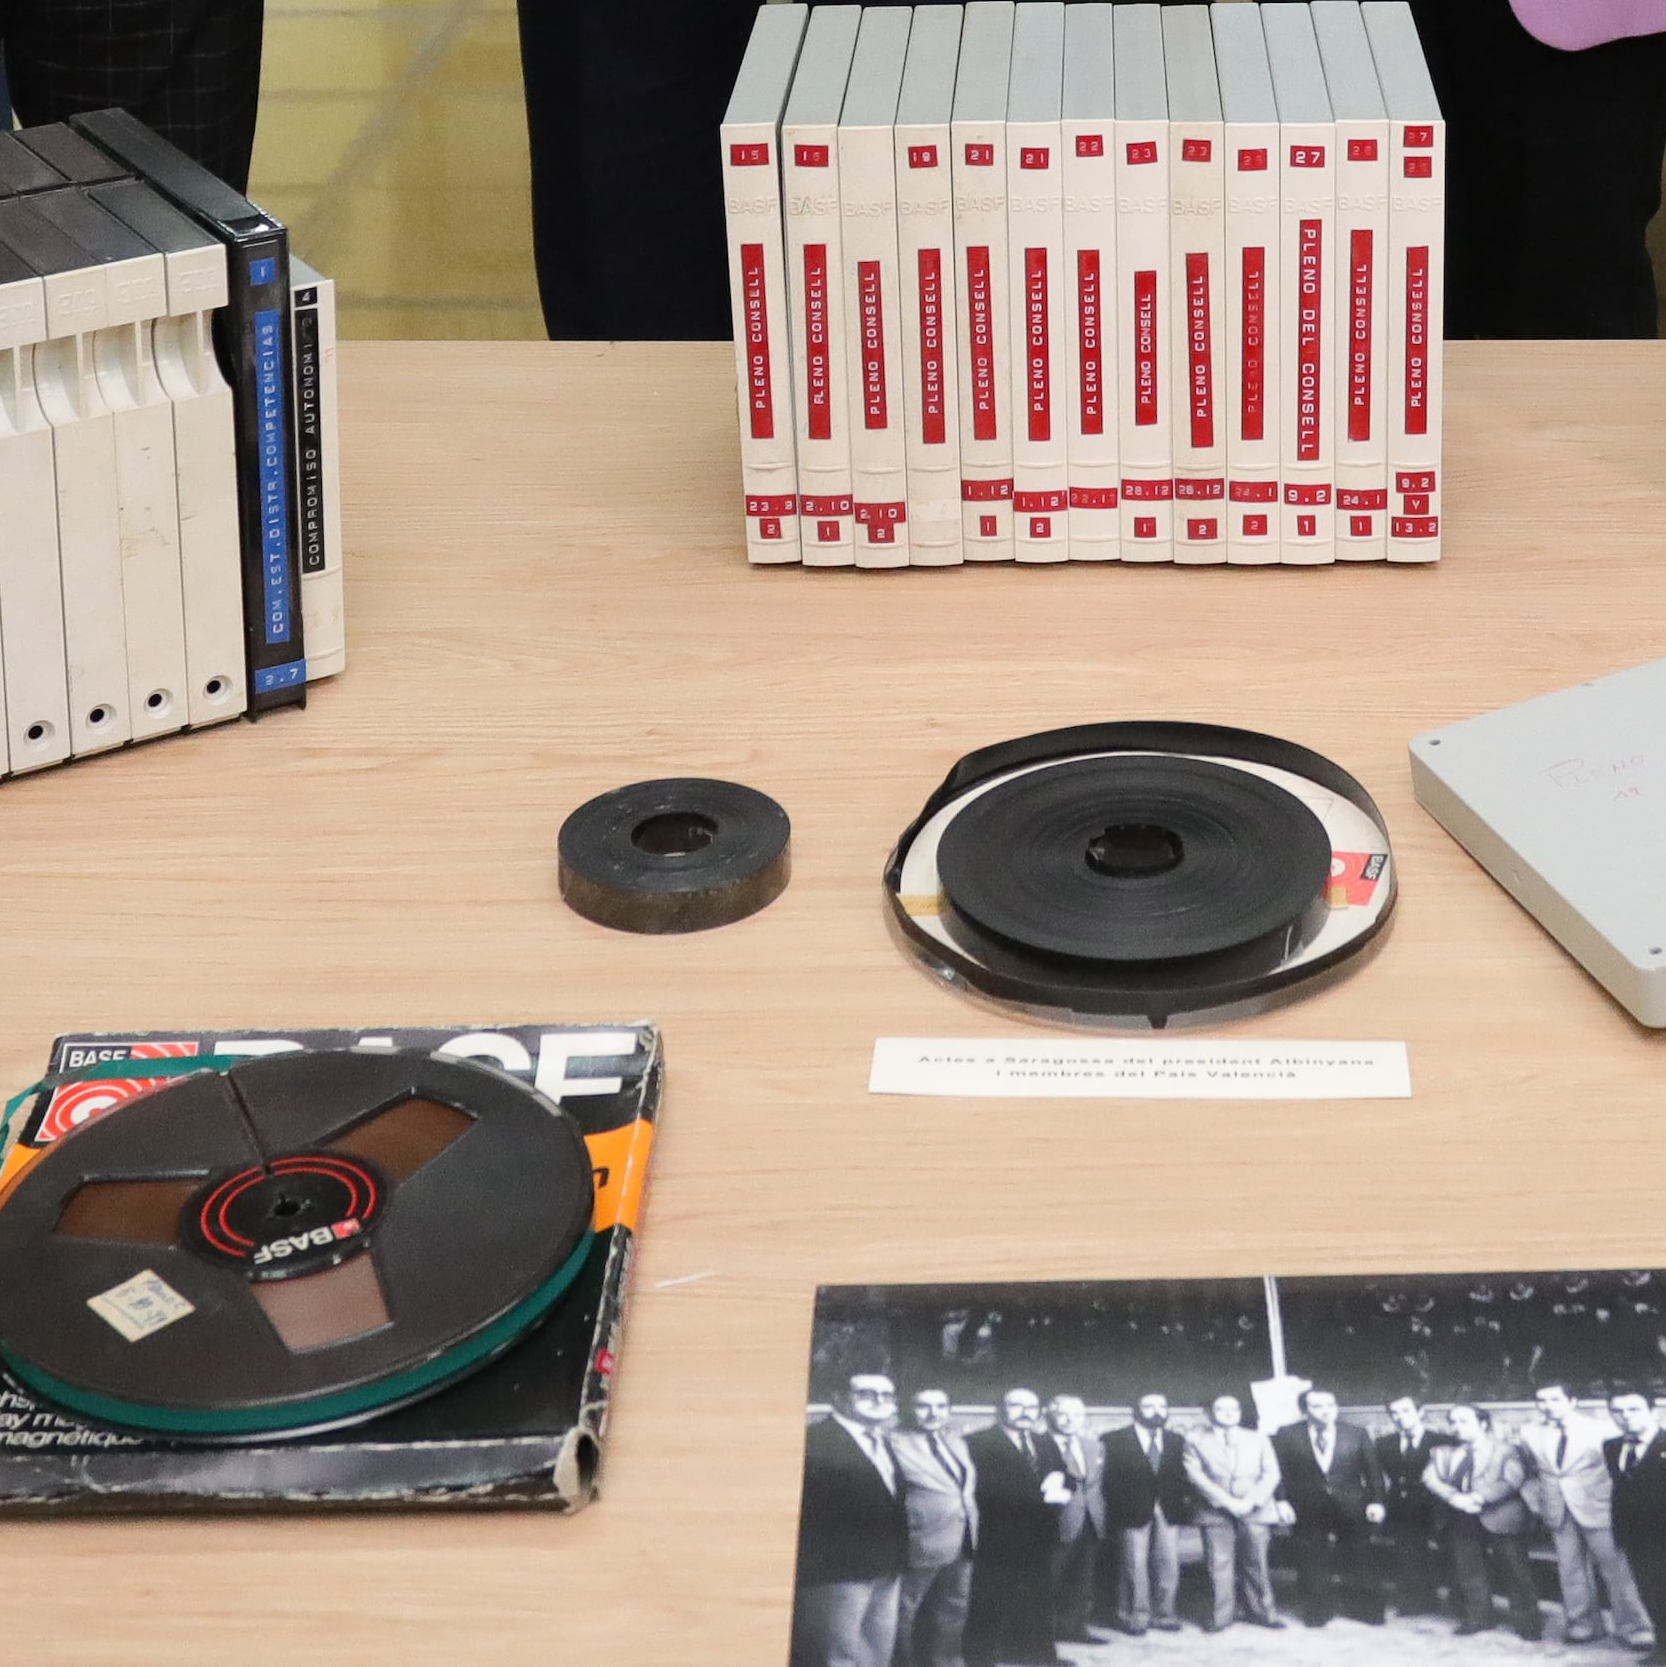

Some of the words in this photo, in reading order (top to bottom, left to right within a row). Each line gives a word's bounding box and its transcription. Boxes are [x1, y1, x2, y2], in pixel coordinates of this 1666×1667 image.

[970, 149, 990, 161] 21
[1025, 152, 1044, 164] 21
[1079, 140, 1099, 152] 22
[1295, 150, 1321, 164] 27
[1303, 228, 1317, 294] PLENO
[301, 291, 311, 302] 4
[749, 267, 762, 342] CONSELL
[811, 268, 823, 343] CONSELL
[864, 273, 877, 348] CONSELL
[925, 272, 937, 348] CONSELL
[974, 270, 986, 344] CONSELL
[1031, 270, 1044, 346] CONSELL
[1084, 273, 1095, 348] CONSELL
[1193, 276, 1205, 351] CONSELL
[1356, 264, 1367, 339] CONSELL
[1412, 268, 1424, 345] CONSELL
[1140, 294, 1151, 353] CONSELL
[1302, 309, 1316, 346] DEL
[753, 355, 766, 409] PLENO
[868, 361, 880, 414] PLENO
[927, 360, 939, 414] PLENO
[977, 357, 989, 410] PLENO
[1033, 358, 1044, 411] PLENO
[1086, 361, 1097, 415] PLENO
[1140, 360, 1151, 404] PLENO
[1195, 365, 1207, 418] PLENO
[1354, 352, 1365, 406] PLENO
[1411, 357, 1422, 407] PLENO
[1301, 362, 1315, 453] CONSELL
[305, 448, 320, 566] COMPROMISO
[967, 484, 1009, 496] 1.12
[1288, 489, 1327, 502] 9.2
[1401, 477, 1430, 489] 9.2
[876, 528, 885, 538] 2
[1036, 523, 1044, 534] 2
[1198, 523, 1207, 534] 2
[1395, 521, 1437, 533] 13.2
[253, 1226, 334, 1265] BASF
